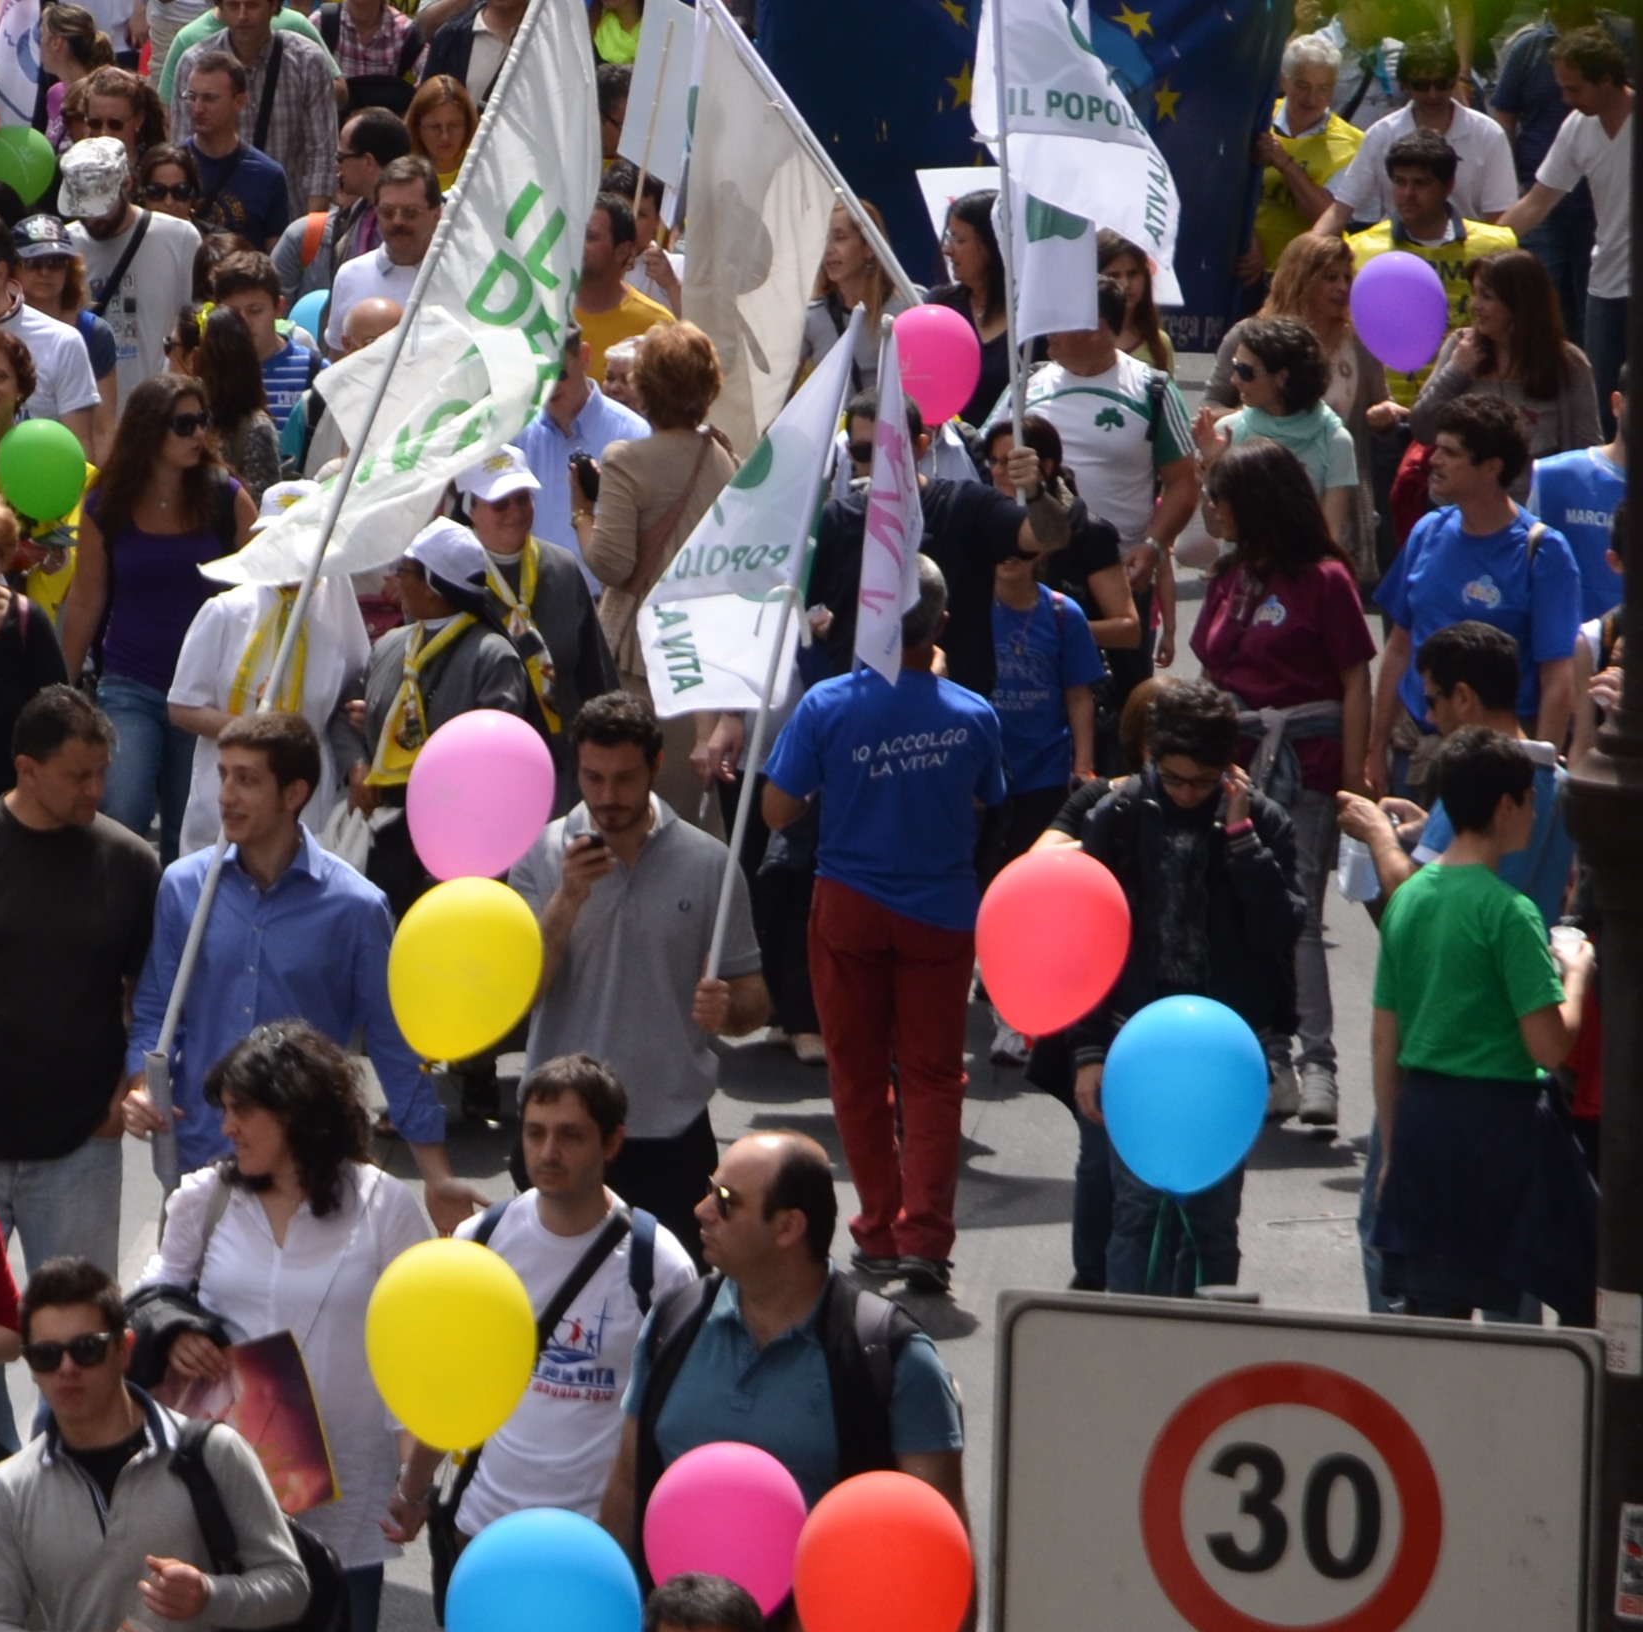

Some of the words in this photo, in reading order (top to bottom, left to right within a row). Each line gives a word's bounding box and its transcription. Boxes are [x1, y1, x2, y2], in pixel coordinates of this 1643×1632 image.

[1007, 87, 1036, 117] IL
[664, 631, 705, 695] VITA
[852, 745, 869, 762] IO
[876, 727, 969, 759] ACCOLGO
[869, 759, 893, 780] LA
[899, 750, 949, 775] VITA!
[1205, 1441, 1383, 1580] 30
